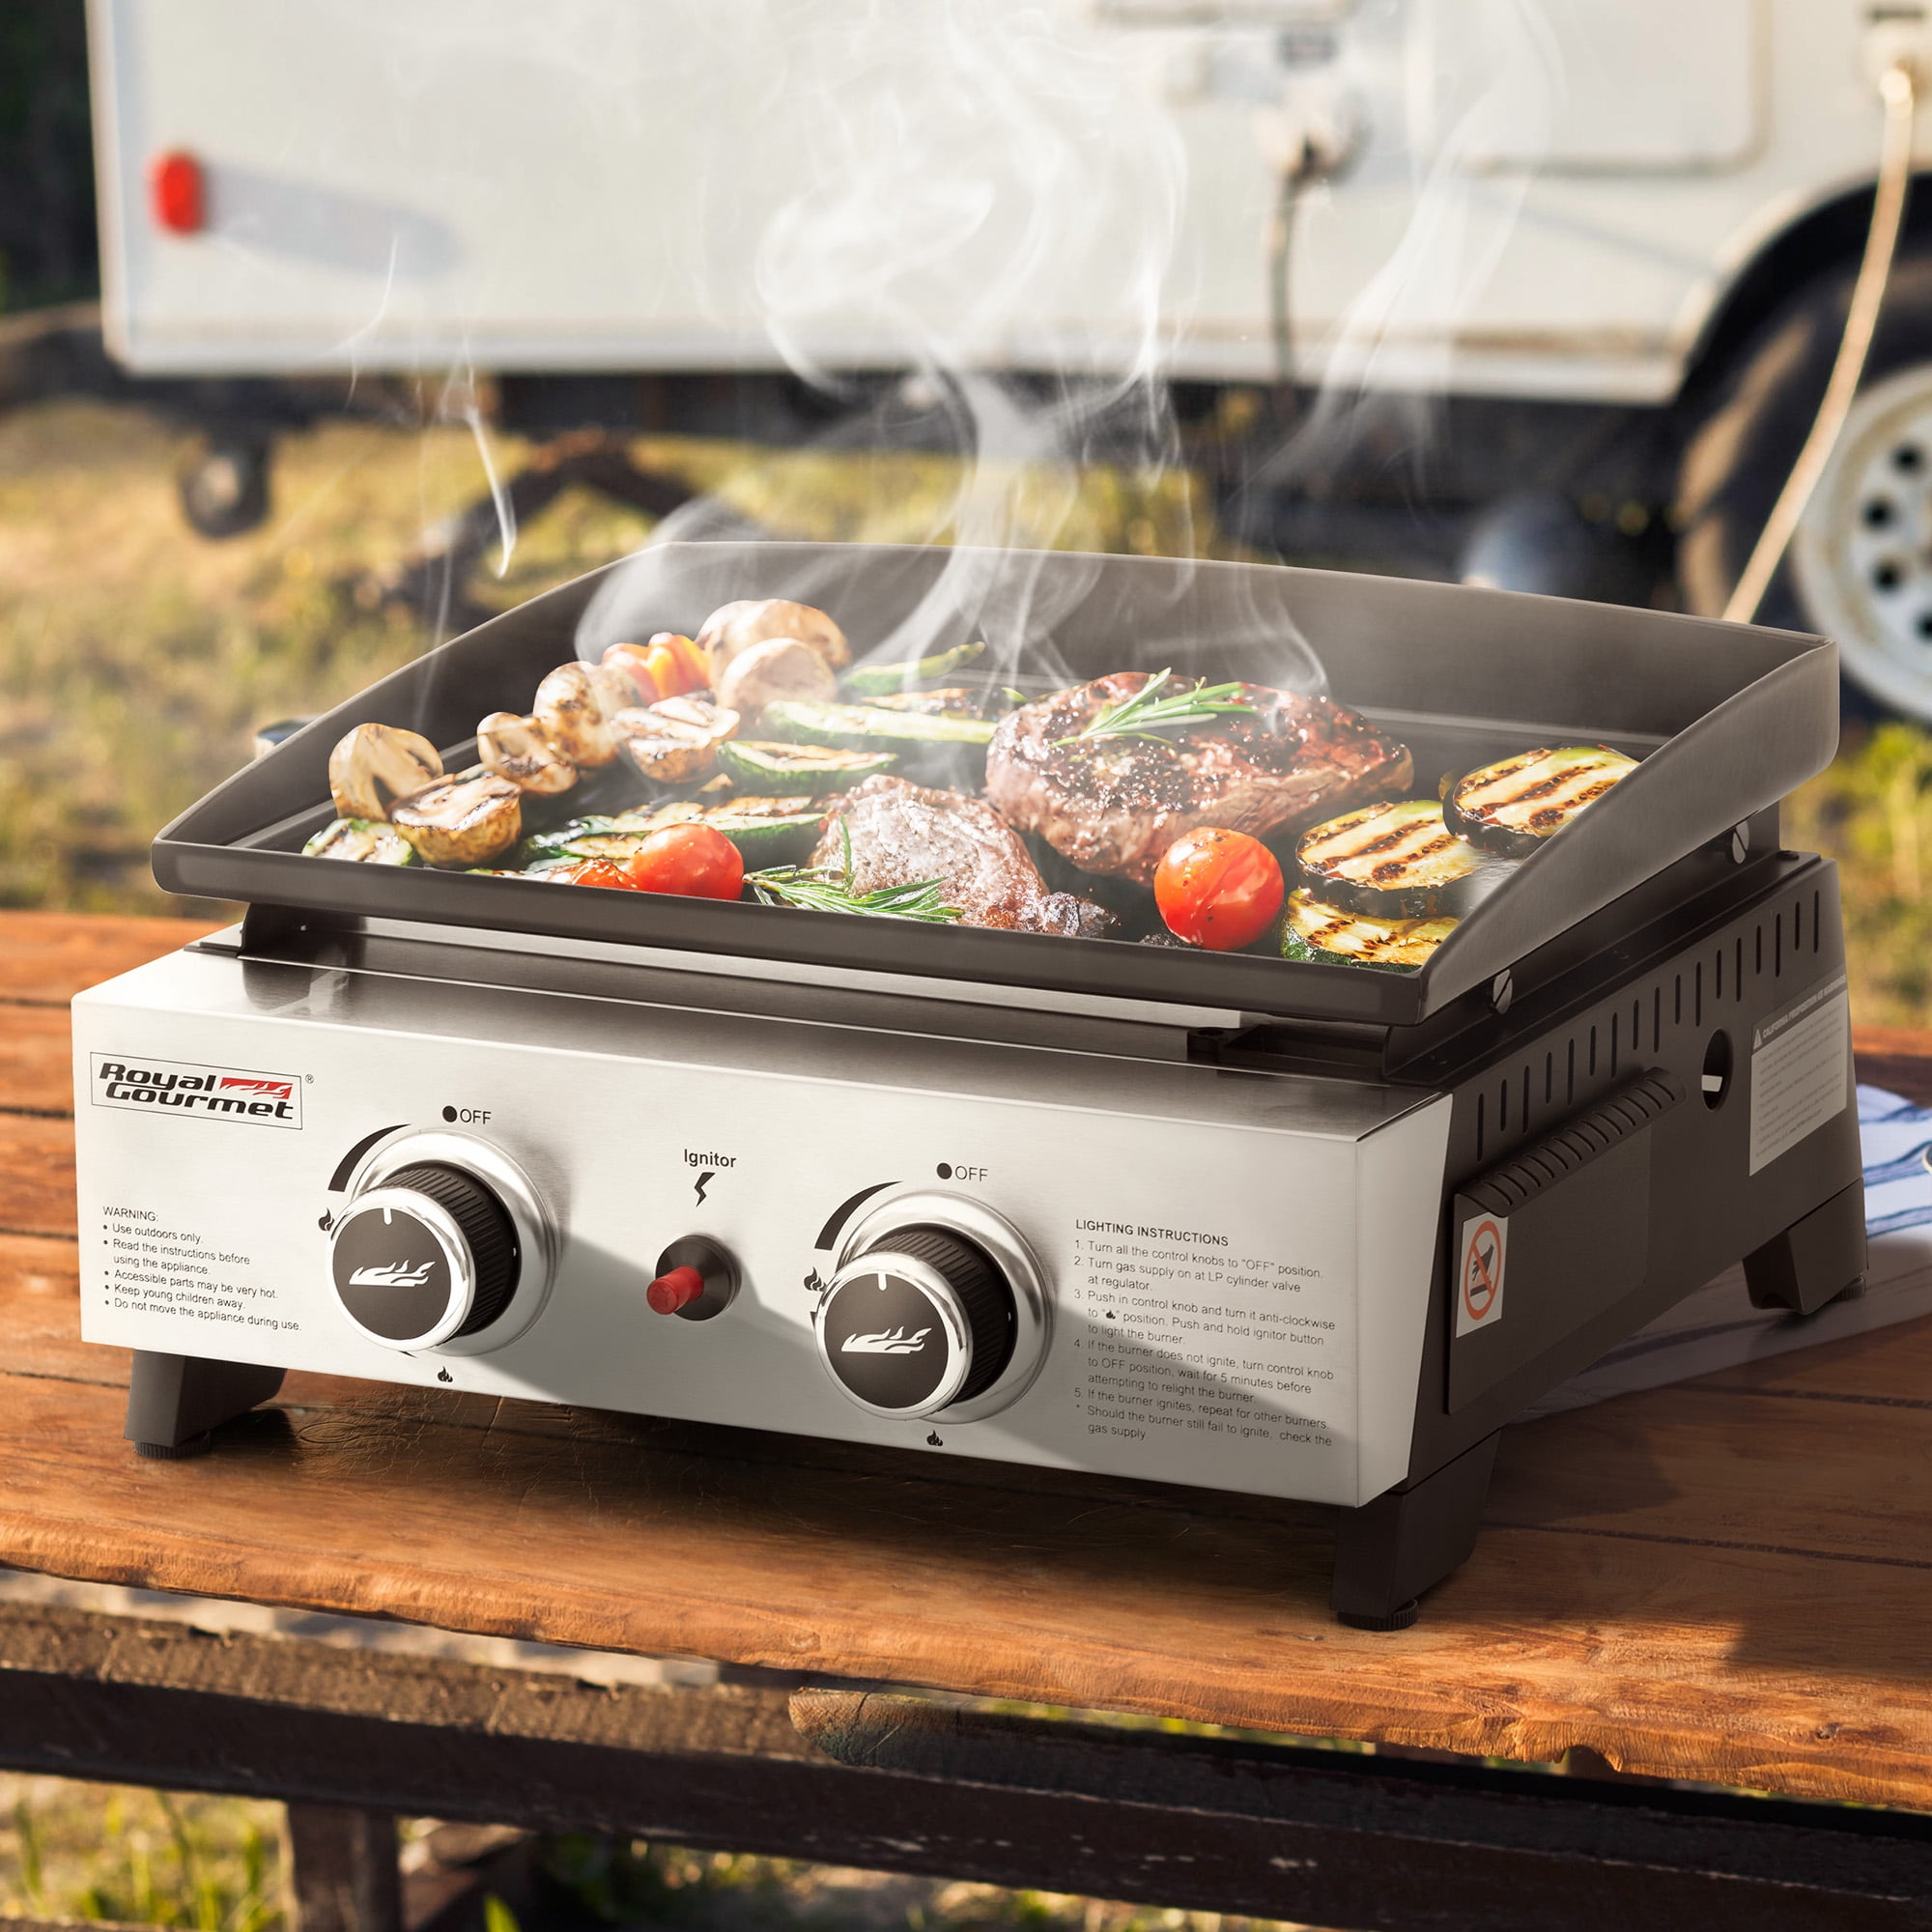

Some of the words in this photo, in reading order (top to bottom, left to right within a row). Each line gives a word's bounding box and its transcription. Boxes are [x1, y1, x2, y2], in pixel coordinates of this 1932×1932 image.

[99, 1062, 216, 1092] Royal
[105, 1082, 294, 1120] Gourmet
[460, 1108, 492, 1125] OFF
[684, 1149, 737, 1168] Ignitor
[954, 1165, 988, 1181] OFF
[102, 1207, 158, 1222] WARNING:
[112, 1223, 131, 1235] Use
[135, 1227, 178, 1240] outdoors
[181, 1233, 204, 1245] only.
[1075, 1219, 1134, 1236] LIGHTING
[1137, 1226, 1229, 1246] INSTRUCTIONS
[113, 1238, 139, 1251] Read
[142, 1242, 157, 1254] the
[160, 1244, 215, 1261] instructions
[219, 1252, 250, 1264] before
[1074, 1239, 1084, 1250] 1.
[1088, 1240, 1113, 1253] Turn
[1116, 1244, 1128, 1255] all
[1131, 1246, 1149, 1257] the
[1151, 1250, 1188, 1263] control
[1192, 1253, 1225, 1266] knobs
[1228, 1259, 1238, 1268] to
[1241, 1259, 1275, 1271] "OFF"
[1278, 1265, 1323, 1279] position.
[114, 1255, 139, 1268] using
[142, 1258, 157, 1268] the
[160, 1261, 211, 1275] appliance.
[1088, 1257, 1113, 1270] Turn
[1116, 1262, 1136, 1274] gas
[1139, 1264, 1175, 1280] supply
[1178, 1269, 1191, 1279] on
[1194, 1270, 1206, 1281] at
[1208, 1271, 1223, 1283] LP
[1227, 1274, 1268, 1288] cylinder
[1272, 1281, 1301, 1293] valve
[114, 1269, 167, 1285] Accessible
[170, 1276, 194, 1289] parts
[197, 1281, 218, 1293] may
[221, 1283, 234, 1293] be
[237, 1286, 258, 1298] very
[260, 1288, 278, 1299] hot.
[1088, 1275, 1098, 1285] at
[1101, 1277, 1152, 1292] regulator.
[114, 1284, 140, 1297] Keep
[143, 1289, 173, 1302] young
[176, 1292, 214, 1305] children
[217, 1298, 246, 1311] away.
[1088, 1290, 1116, 1303] Push
[1119, 1294, 1128, 1304] in
[1131, 1296, 1169, 1310] control
[1172, 1300, 1199, 1314] knob
[1202, 1305, 1222, 1316] and
[1225, 1308, 1247, 1320] turn
[1249, 1310, 1256, 1321] it
[1259, 1313, 1335, 1330] anti-clockwise
[114, 1297, 128, 1309] Do
[131, 1301, 147, 1312] not
[150, 1304, 177, 1315] move
[180, 1306, 194, 1317] the
[197, 1310, 244, 1323] appliance
[247, 1315, 279, 1330] during
[281, 1321, 302, 1331] use.
[1088, 1308, 1098, 1318] to
[1123, 1312, 1169, 1327] position.
[1172, 1317, 1200, 1332] Push
[1203, 1322, 1223, 1333] and
[1227, 1323, 1250, 1337] hold
[1253, 1328, 1287, 1341] ignitor
[1290, 1332, 1324, 1346] button
[1088, 1324, 1098, 1334] to
[1101, 1324, 1123, 1339] light
[1127, 1328, 1145, 1340] the
[1148, 1331, 1186, 1346] burner.
[1088, 1339, 1095, 1350] If
[1097, 1342, 1115, 1353] the
[1118, 1345, 1154, 1357] burner
[1156, 1350, 1183, 1361] does
[1186, 1353, 1204, 1364] not
[1242, 1360, 1264, 1372] turn
[1266, 1363, 1304, 1378] control
[1307, 1367, 1334, 1380] knob
[1088, 1357, 1098, 1367] to
[1101, 1357, 1126, 1370] OFF
[1178, 1368, 1201, 1381] wait
[1203, 1370, 1217, 1382] for
[1220, 1373, 1228, 1383] 5
[1231, 1376, 1273, 1389] minutes
[1276, 1380, 1312, 1394] before
[1088, 1374, 1145, 1392] attempting
[1148, 1380, 1158, 1391] to
[1161, 1383, 1196, 1398] relight
[1198, 1386, 1215, 1399] the
[1088, 1388, 1095, 1399] If
[1097, 1391, 1115, 1402] the
[1118, 1393, 1153, 1406] burner
[1198, 1404, 1233, 1418] repeat
[1236, 1406, 1251, 1419] for
[1254, 1410, 1282, 1423] other
[1285, 1413, 1330, 1430] burners.
[1088, 1405, 1125, 1420] Should
[1127, 1410, 1145, 1422] the
[1148, 1413, 1183, 1428] burner
[1186, 1417, 1205, 1430] still
[1208, 1419, 1224, 1433] fail
[1227, 1423, 1237, 1435] to
[1279, 1430, 1312, 1444] check
[1315, 1434, 1332, 1447] the
[1088, 1424, 1108, 1435] gas
